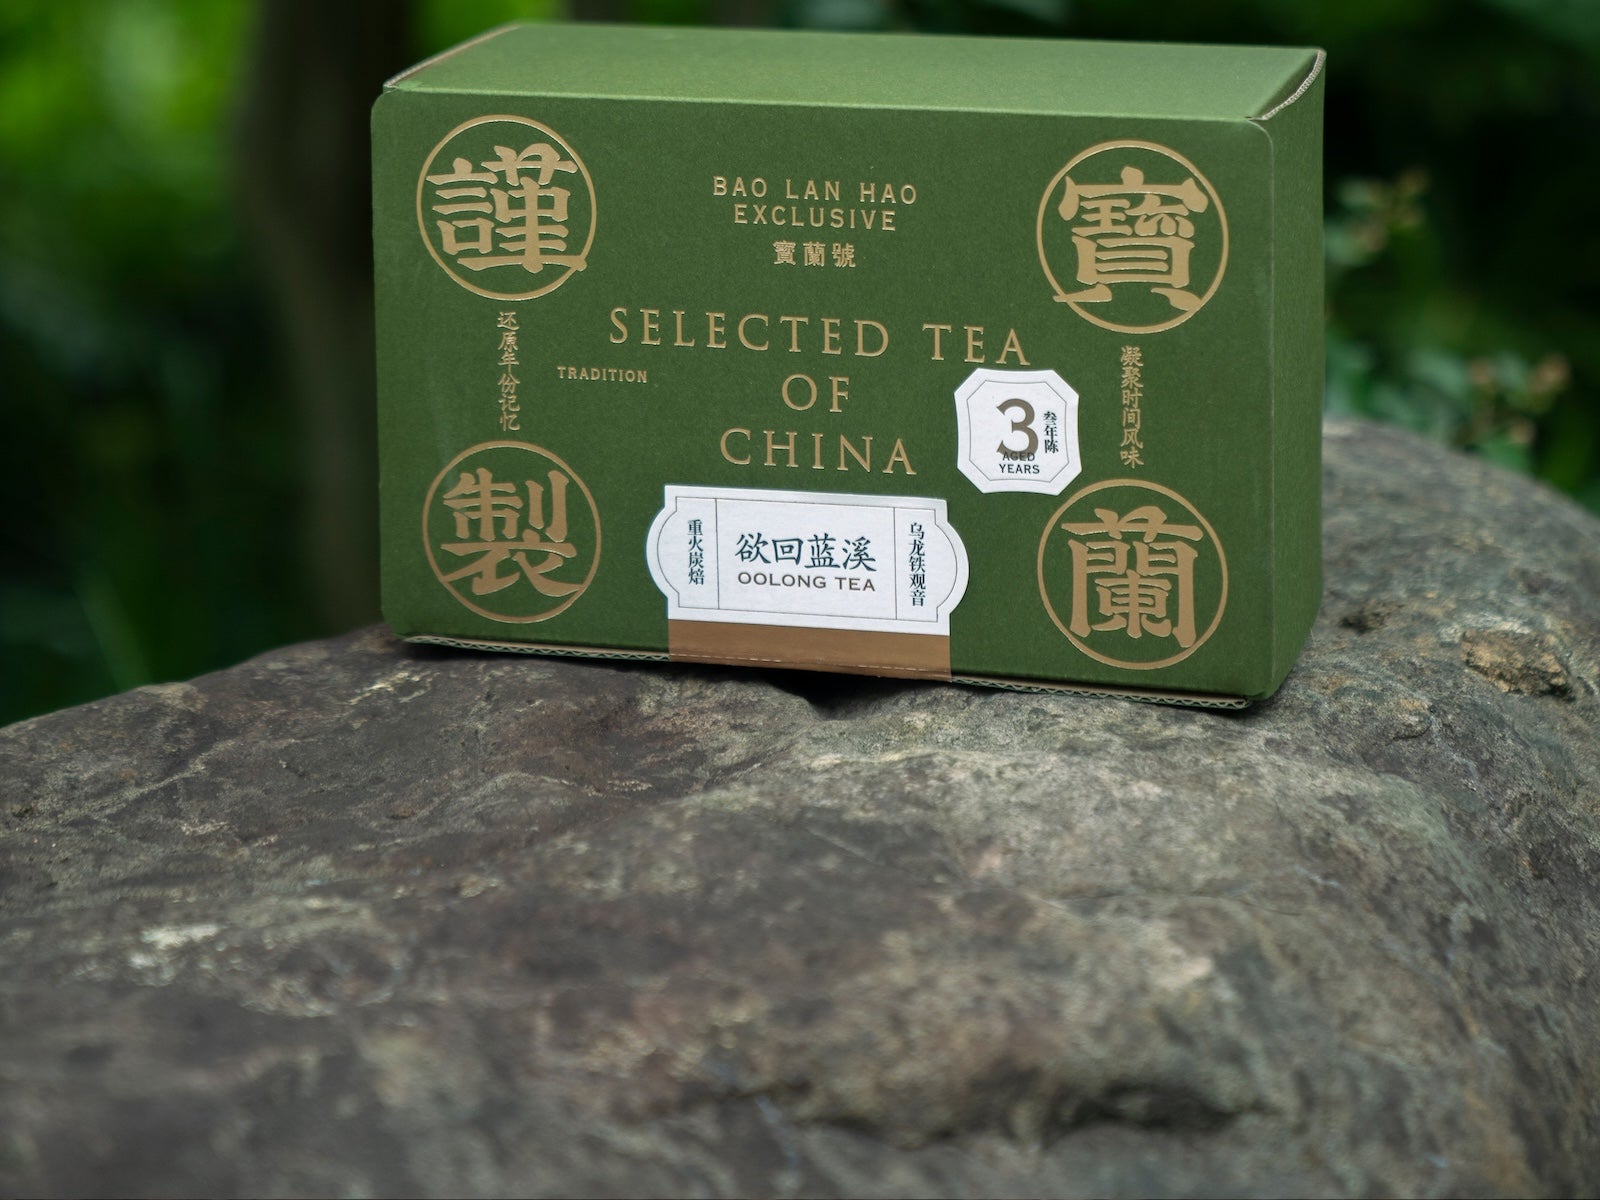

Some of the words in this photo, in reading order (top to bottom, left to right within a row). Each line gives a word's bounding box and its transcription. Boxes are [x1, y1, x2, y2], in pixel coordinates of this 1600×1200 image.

[426, 142, 588, 274] 謹
[713, 175, 768, 198] BAO
[786, 178, 840, 201] LAN
[859, 182, 917, 205] HAO
[734, 203, 896, 231] EXCLUSIVE
[609, 307, 890, 357] SELECTED
[922, 322, 1031, 366] TEA
[497, 311, 521, 432] 还原年份记忆
[557, 366, 648, 383] TRADITION
[781, 374, 850, 413] OF
[996, 398, 1039, 460] 3
[1120, 345, 1145, 469] 凝聚时间风味
[719, 427, 917, 476] CHINA
[1002, 451, 1036, 462] AGED
[1043, 410, 1059, 454] 叁年陈
[998, 463, 1040, 475] YEARS
[440, 467, 585, 599] 製
[687, 519, 705, 586] 重火炭焙
[734, 532, 878, 573] 欲回蓝溪
[737, 571, 827, 589] OOLONG
[834, 576, 877, 592] TEA
[908, 521, 927, 608] 乌龙铁观音
[1060, 505, 1205, 649] 蘭
